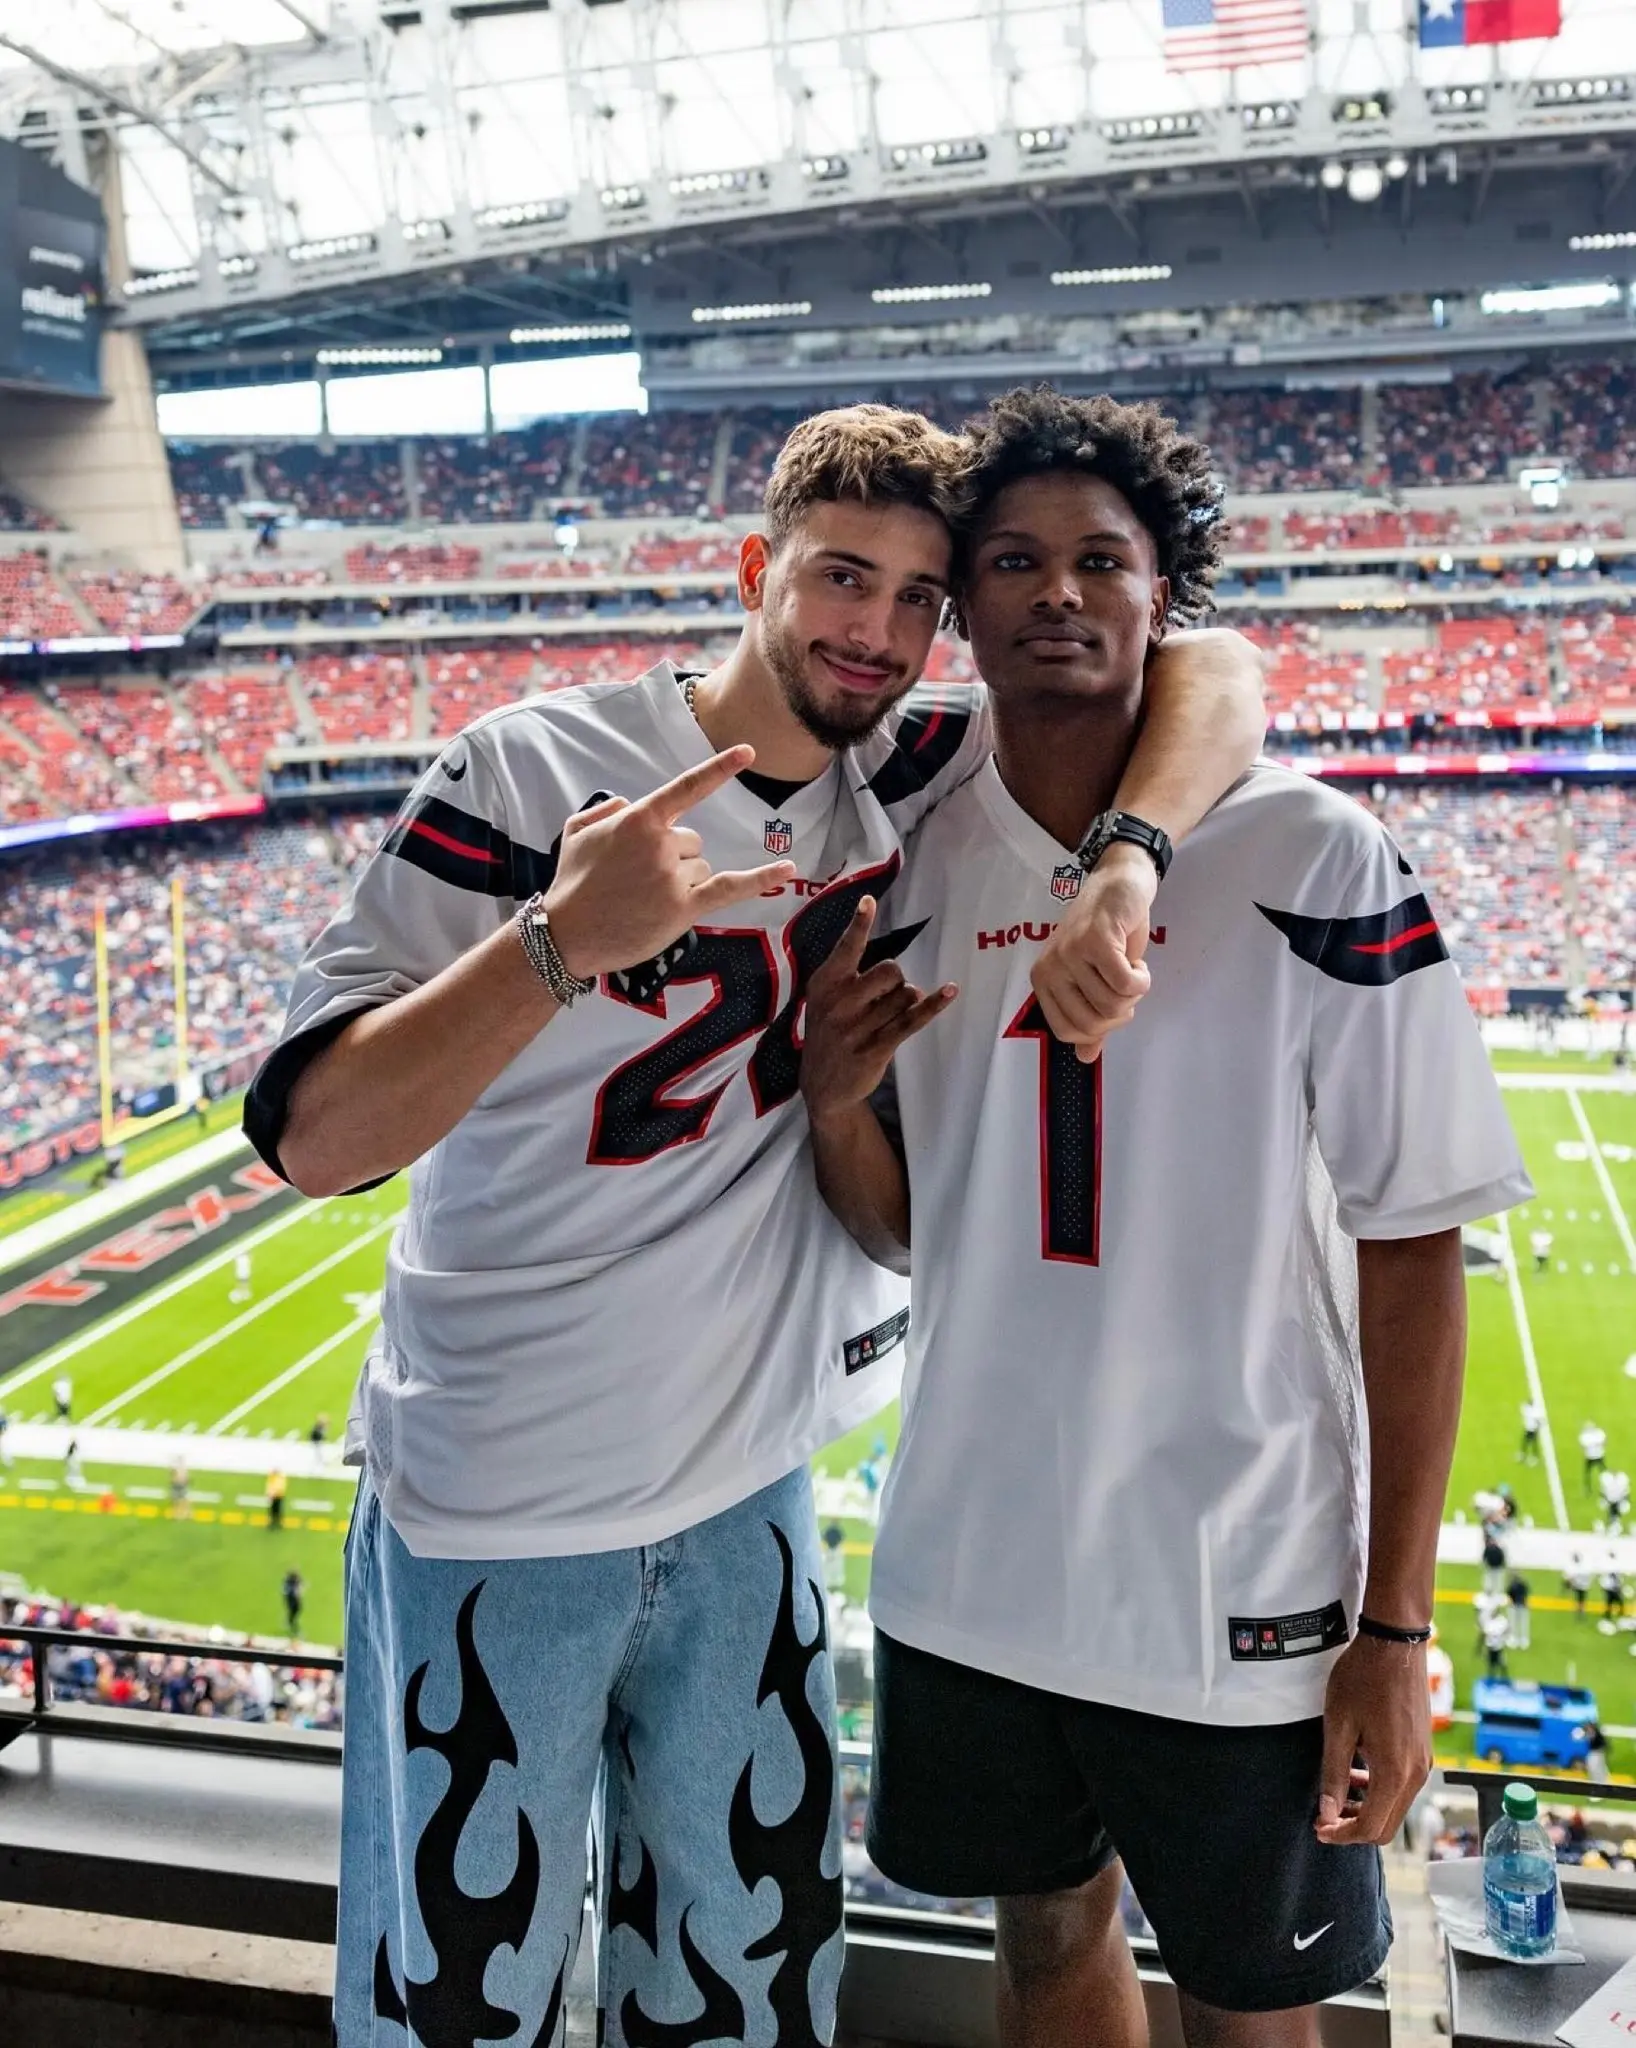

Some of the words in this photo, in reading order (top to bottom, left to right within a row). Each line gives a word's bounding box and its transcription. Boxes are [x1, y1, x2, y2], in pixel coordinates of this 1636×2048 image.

[767, 833, 790, 851] NFL
[1053, 878, 1077, 896] NFL
[977, 921, 1166, 949] HOUN
[1002, 989, 1103, 1267] 1
